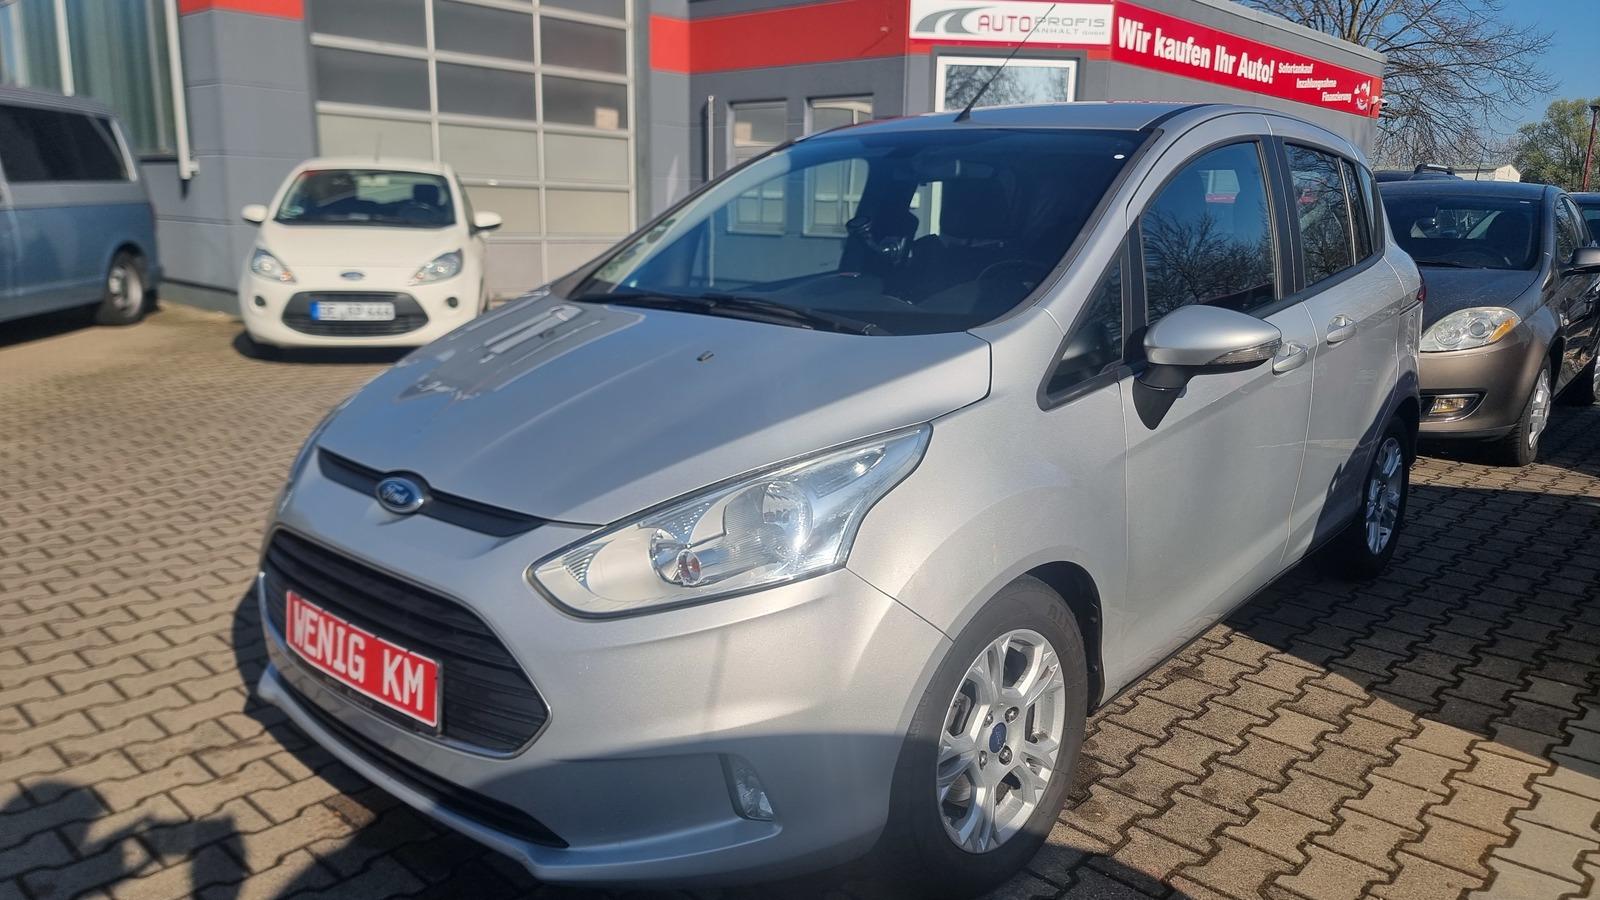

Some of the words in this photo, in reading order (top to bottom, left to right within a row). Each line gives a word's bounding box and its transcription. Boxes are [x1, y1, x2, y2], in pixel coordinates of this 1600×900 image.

[1118, 16, 1152, 53] Wir
[1154, 27, 1212, 69] kaufen
[1213, 44, 1236, 75] Ihr
[1237, 51, 1275, 85] Auto!
[293, 600, 365, 684] WENIG
[383, 648, 424, 711] KM
